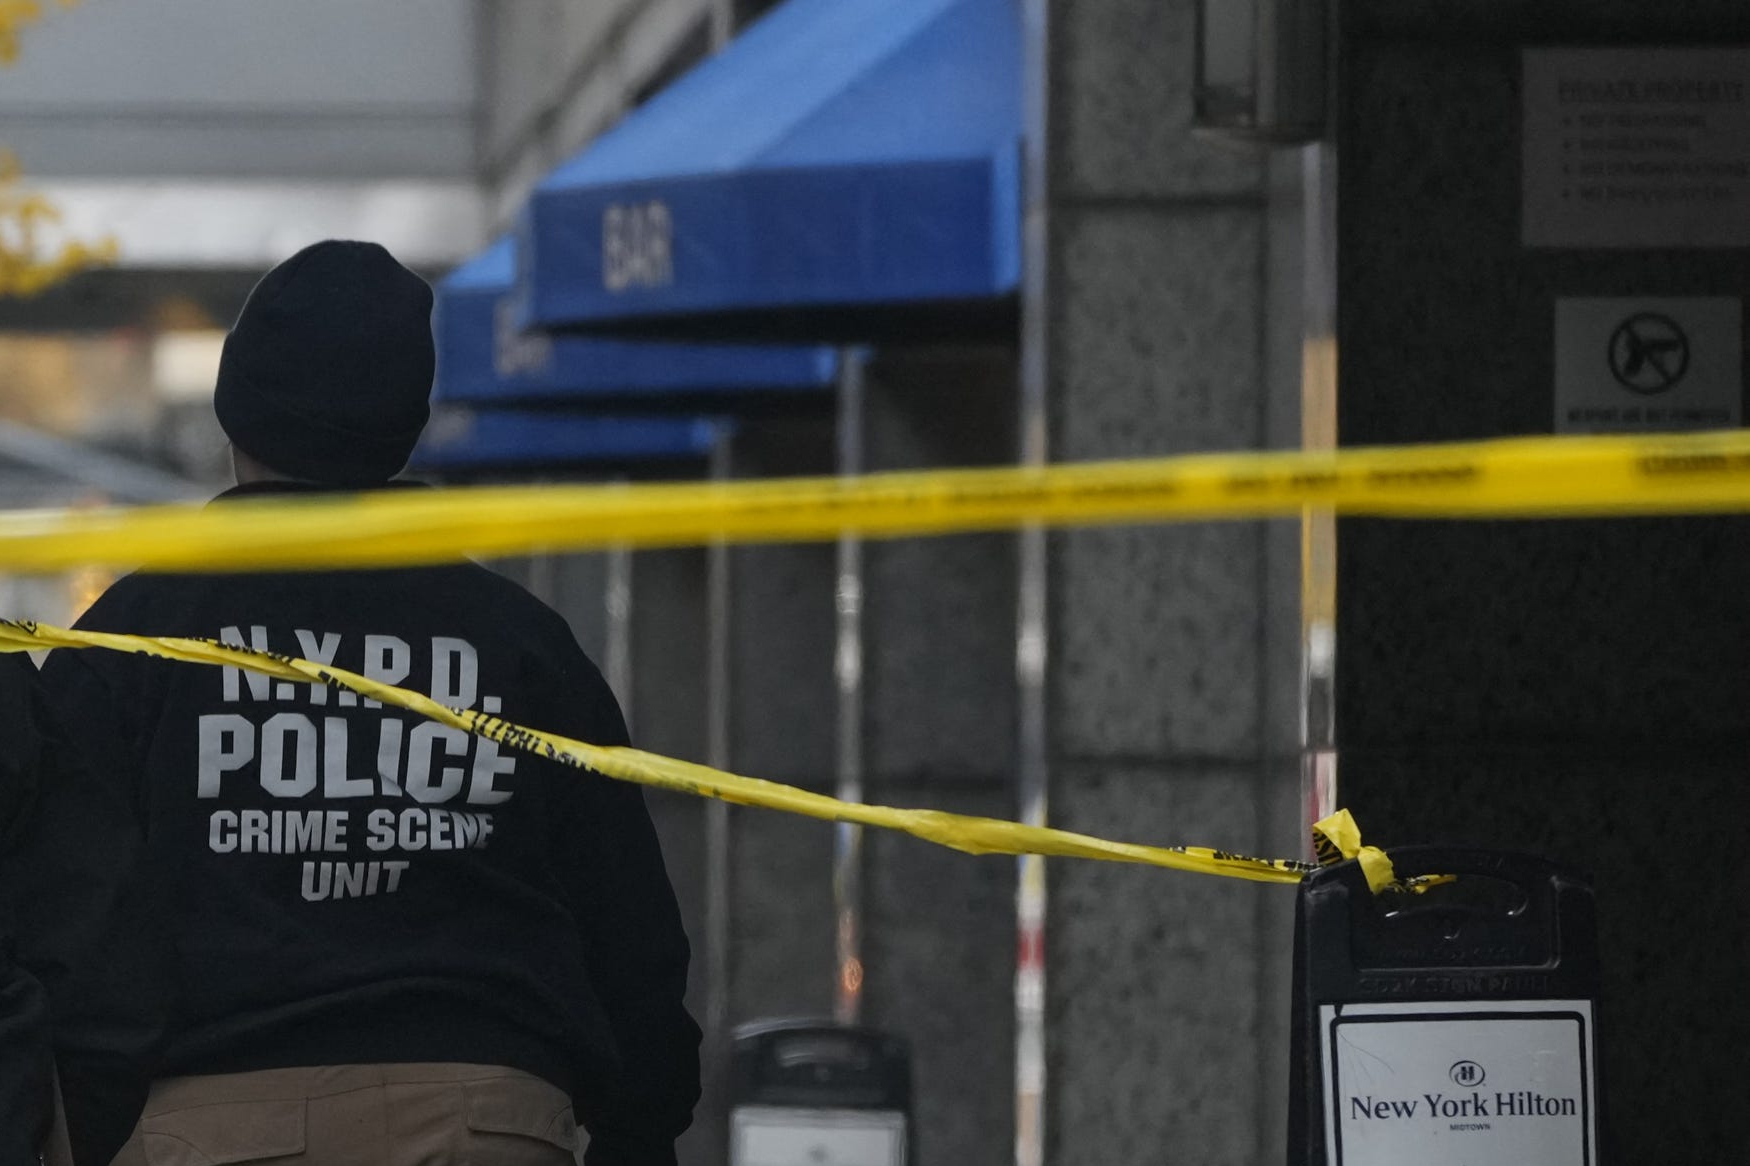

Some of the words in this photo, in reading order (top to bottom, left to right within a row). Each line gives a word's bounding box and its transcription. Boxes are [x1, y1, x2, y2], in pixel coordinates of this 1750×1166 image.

[602, 202, 674, 291] BAR
[220, 626, 502, 713] N.Y.PD.
[197, 713, 516, 805] POLICE
[209, 810, 349, 854] CRIME
[367, 808, 494, 851] SCENE
[301, 861, 410, 901] UNIT
[1351, 1096, 1417, 1120] New
[1423, 1092, 1489, 1118] York
[1496, 1091, 1577, 1116] Hilton
[1449, 1123, 1491, 1131] MIDTOWN
